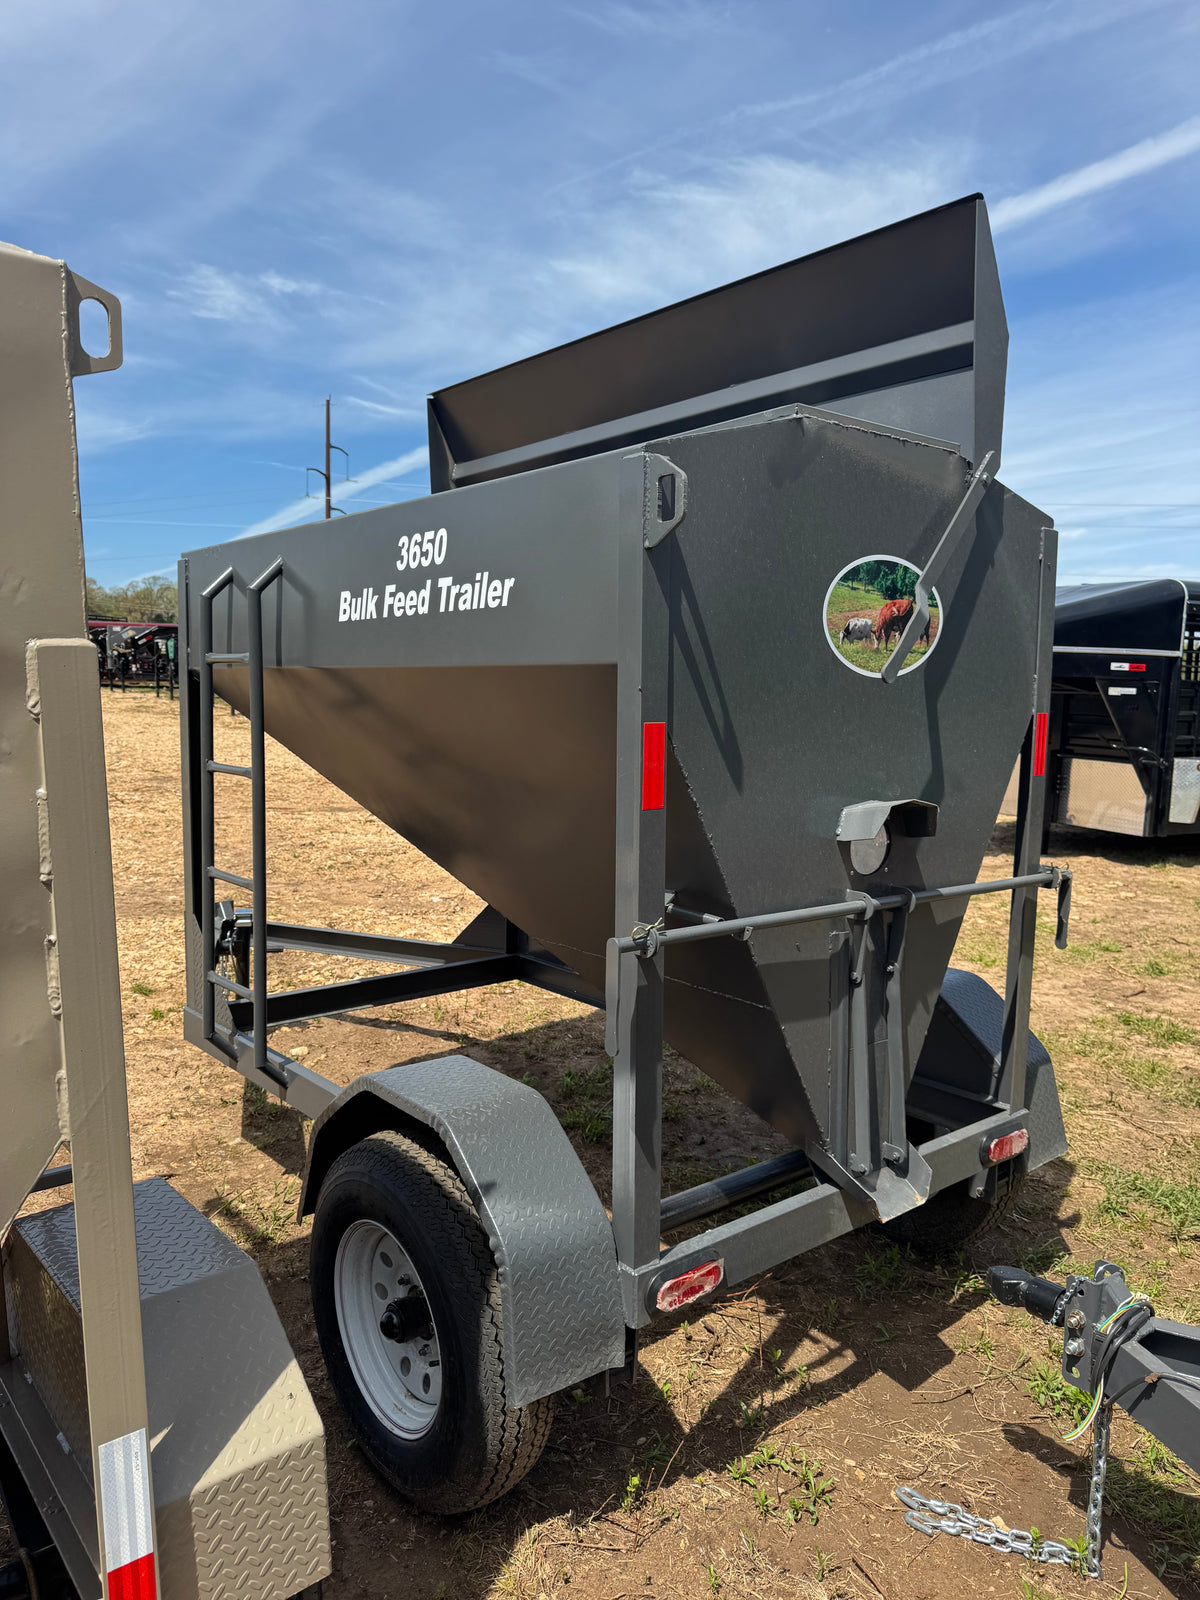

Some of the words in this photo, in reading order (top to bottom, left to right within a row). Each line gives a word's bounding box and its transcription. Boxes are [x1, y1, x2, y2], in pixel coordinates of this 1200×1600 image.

[396, 528, 448, 571] 3650
[338, 587, 379, 623] Bulk
[382, 579, 432, 619] Feed
[437, 571, 516, 614] Trailer
